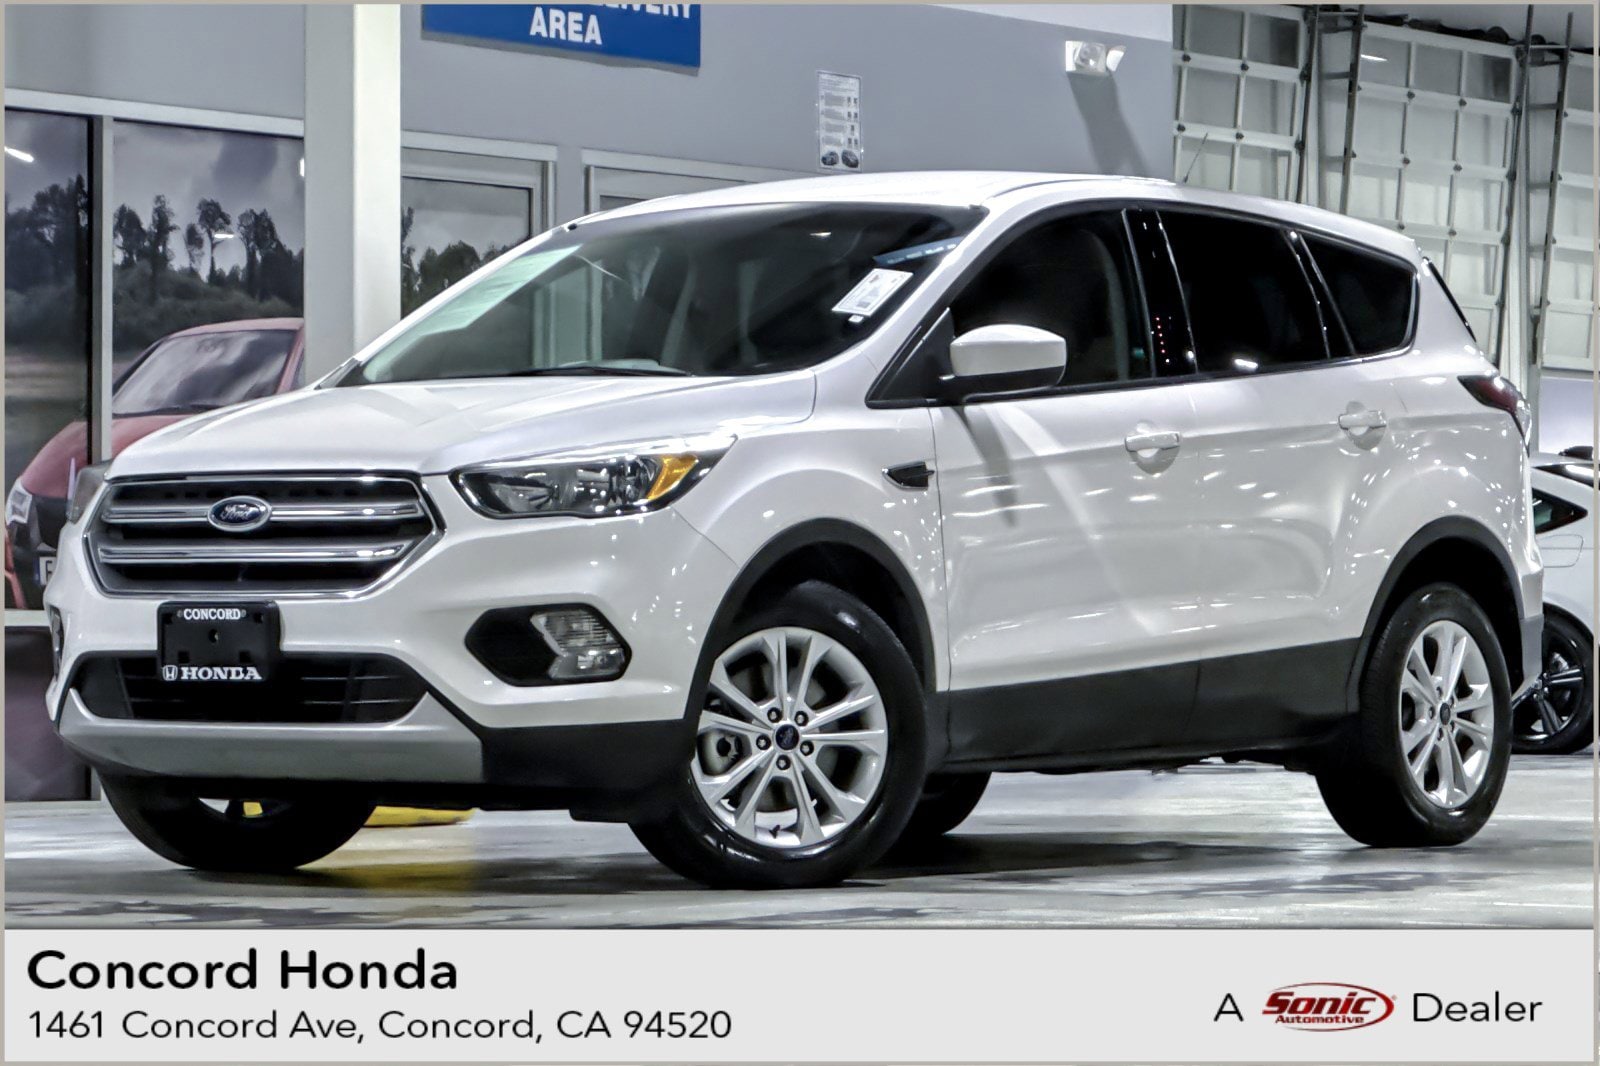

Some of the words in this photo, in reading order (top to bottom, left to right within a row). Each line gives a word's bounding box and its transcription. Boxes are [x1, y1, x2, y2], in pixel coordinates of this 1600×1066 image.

[529, 6, 603, 45] AREA
[183, 608, 241, 621] CONCORD
[181, 666, 262, 681] HONDA
